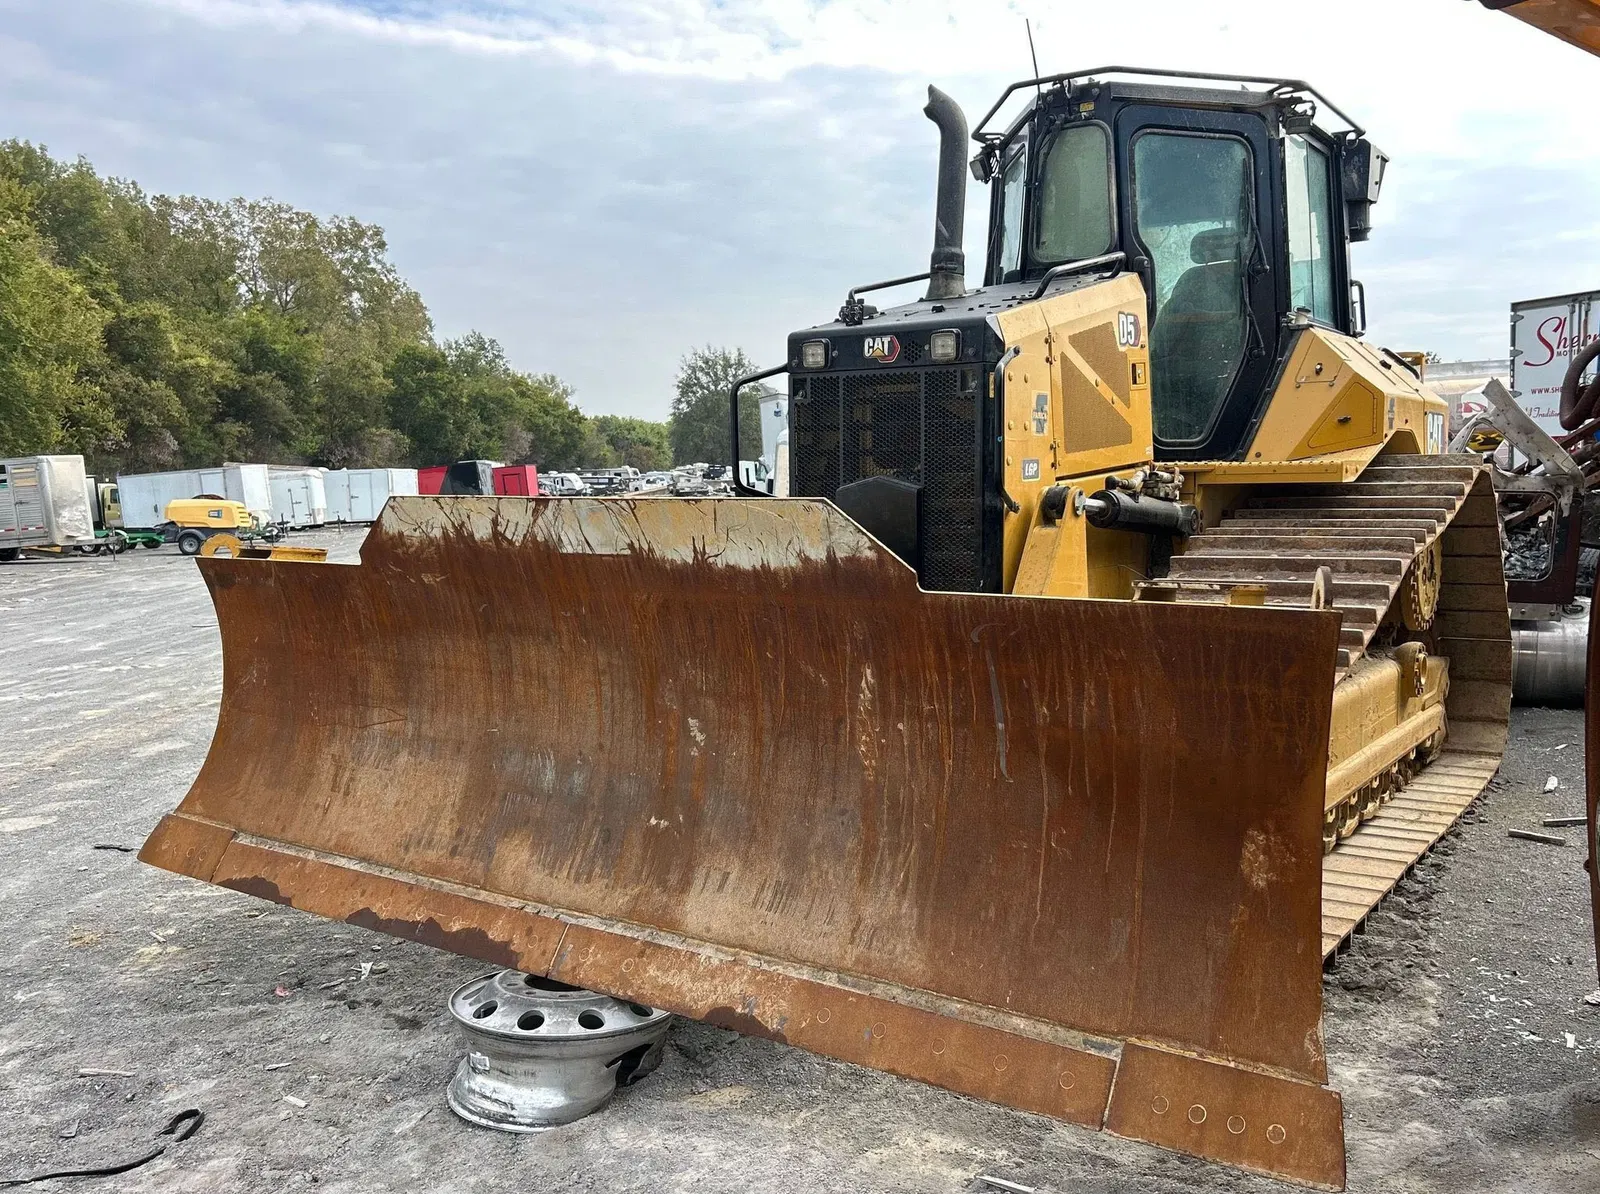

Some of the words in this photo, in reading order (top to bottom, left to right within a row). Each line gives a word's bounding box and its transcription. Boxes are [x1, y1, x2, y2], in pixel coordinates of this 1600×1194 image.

[1118, 312, 1136, 346] D5
[863, 336, 891, 358] CAT
[1427, 412, 1443, 455] CAT
[1024, 461, 1038, 477] LGP
